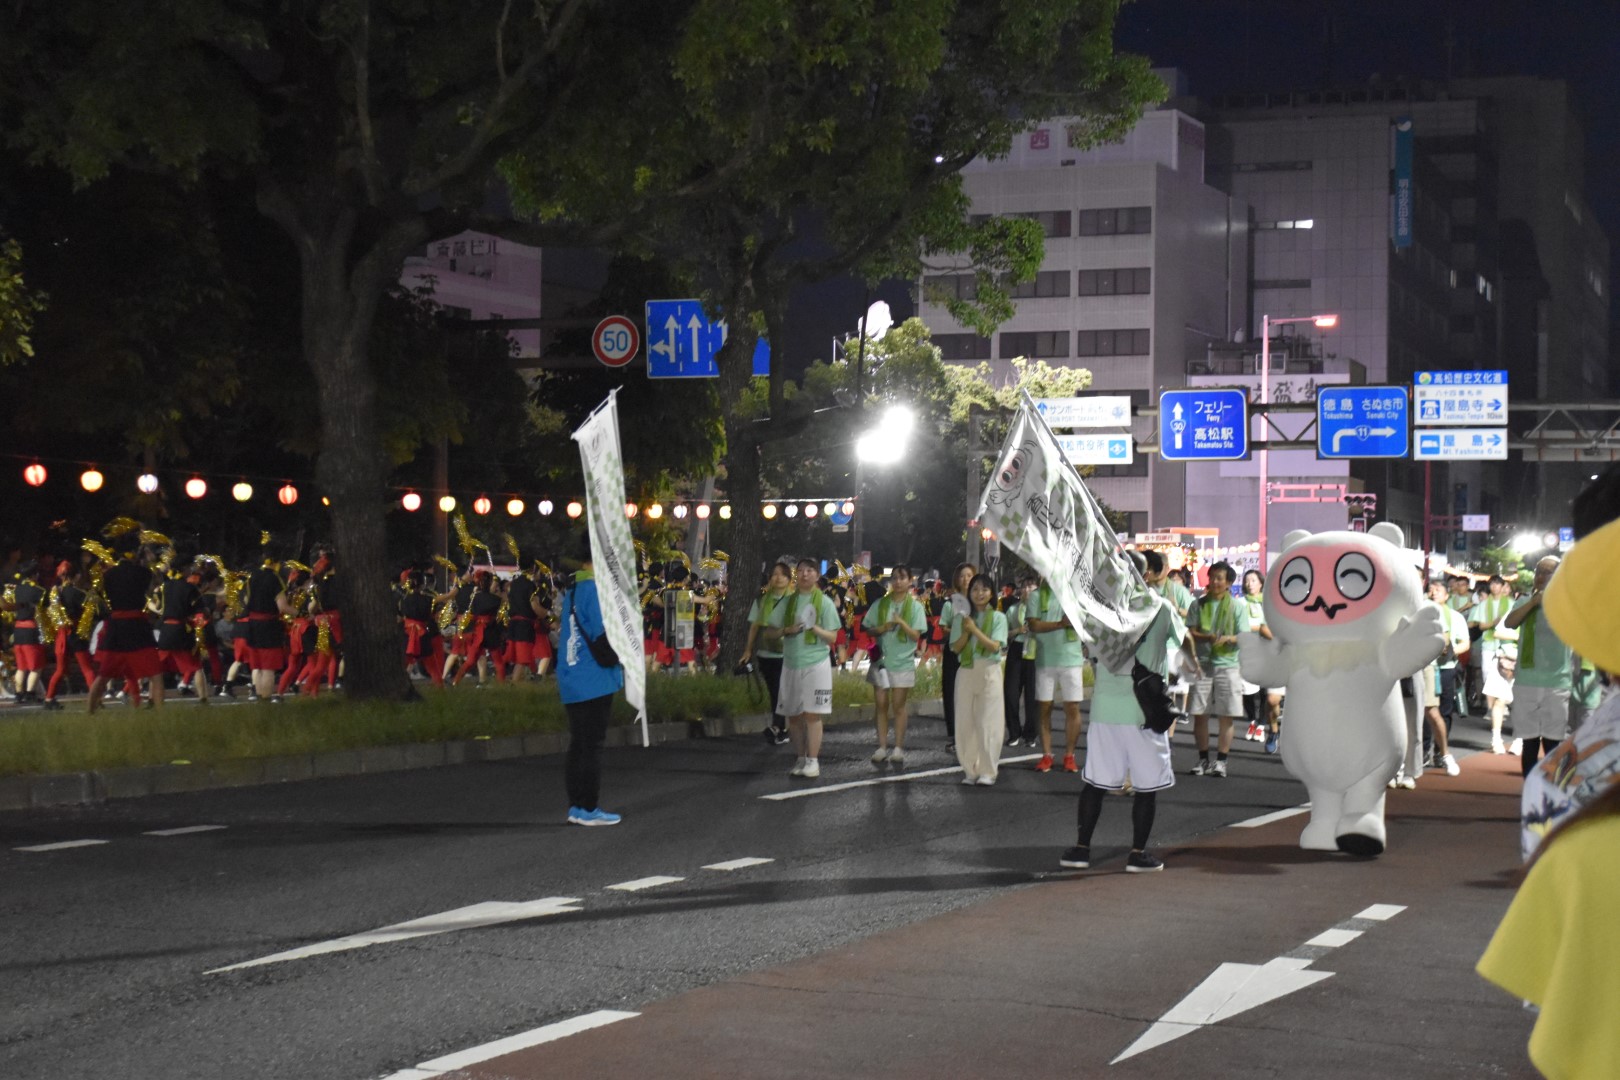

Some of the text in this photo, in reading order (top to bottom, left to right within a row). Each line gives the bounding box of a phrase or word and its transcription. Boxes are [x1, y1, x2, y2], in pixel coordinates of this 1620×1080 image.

[603, 330, 629, 352] 50
[1194, 400, 1232, 414] フェリー
[1323, 397, 1403, 411] 徳島 さぬき市
[1443, 399, 1484, 411] 屋島寺
[1206, 414, 1221, 423] Ferry
[1323, 411, 1399, 421] Tokushima Sanuki City
[1194, 427, 1234, 441] 高松駅
[1358, 427, 1368, 437] 11
[1194, 441, 1223, 449] Takamatsu
[1443, 435, 1484, 447] 屋島
